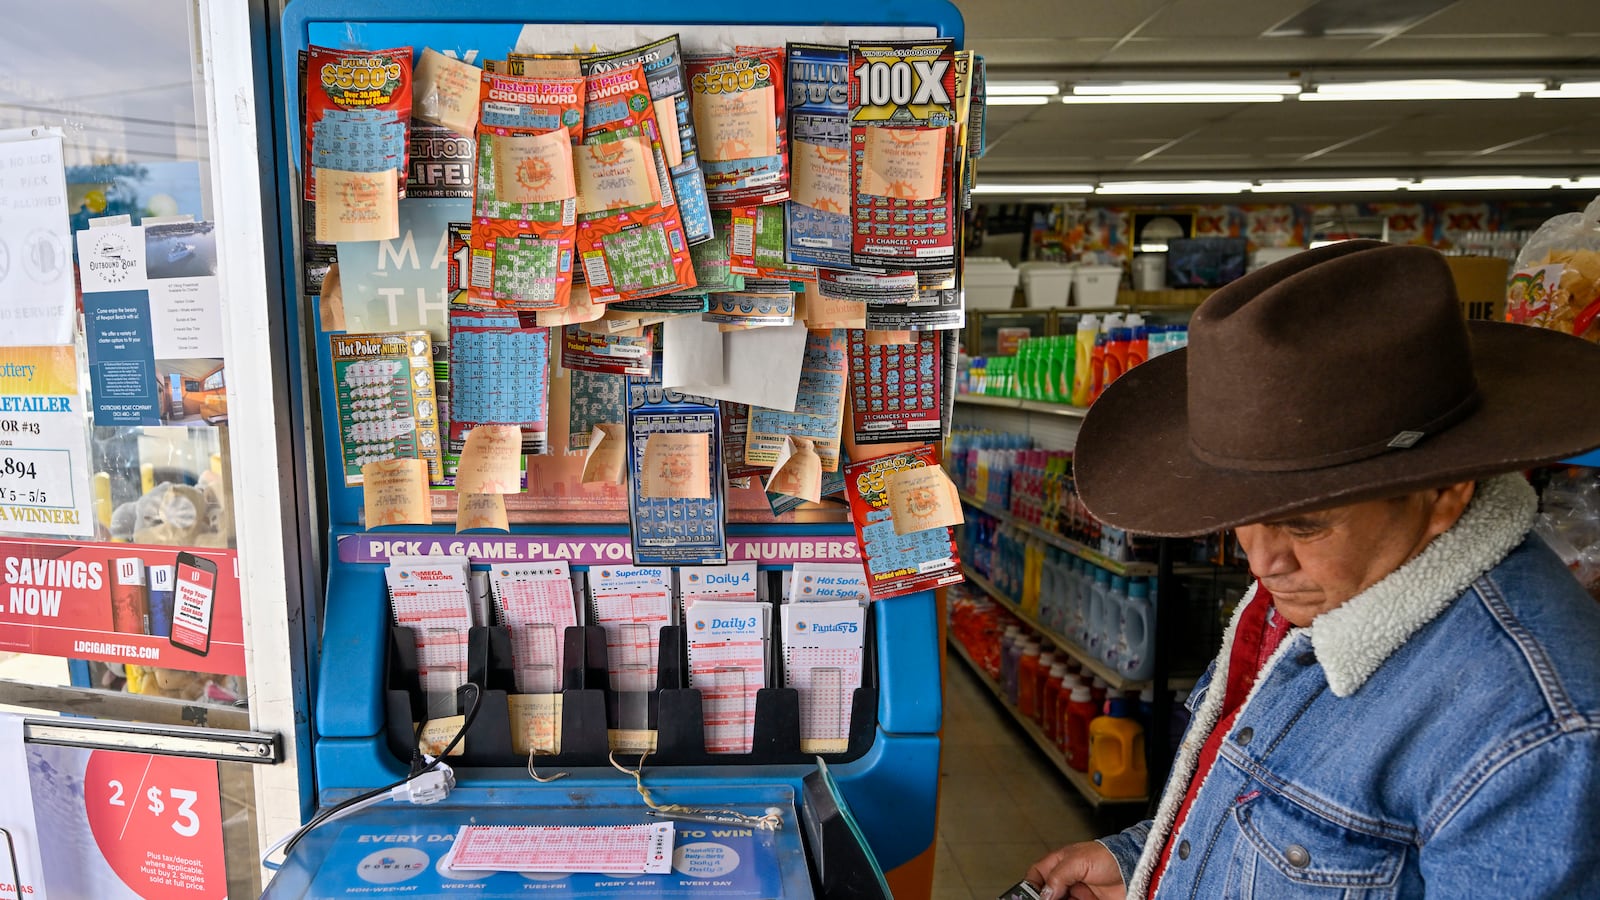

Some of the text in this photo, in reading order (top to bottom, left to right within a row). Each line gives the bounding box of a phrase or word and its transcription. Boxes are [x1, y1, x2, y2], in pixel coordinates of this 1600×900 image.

[342, 58, 382, 68] FULL OF
[710, 61, 749, 74] FULL OF
[321, 63, 400, 90] $500'S
[601, 73, 632, 88] Prize
[854, 60, 951, 107] 100X
[494, 80, 574, 94] Instant Prize
[333, 96, 345, 104] Top
[489, 90, 577, 104] CROSSWORD
[409, 138, 472, 159] ET FOR
[338, 340, 408, 356] Hot Poker NIGHTS
[22, 421, 40, 435] #13
[871, 458, 907, 473] FULL OF
[10, 491, 16, 502] 5
[29, 489, 46, 503] 5/5
[9, 507, 79, 524] WINNER!
[370, 541, 860, 559] PICK A GAME. PLAY NUMBERS.
[5, 557, 103, 590] SAVINGS
[616, 569, 662, 578] SuperLotto
[706, 572, 750, 586] Daily 4
[816, 577, 859, 585] Hot Spot
[815, 588, 858, 598] Hot Spot
[9, 588, 62, 617] NOW
[711, 617, 757, 630] Daily 3
[812, 622, 858, 633] Fantasy 5
[74, 640, 159, 659] LDCIGARETTES.COM
[108, 780, 125, 806] 2
[357, 829, 752, 843] EVERY TO WIN
[146, 851, 161, 860] Plus
[145, 860, 166, 868] where
[140, 866, 157, 875] Must
[158, 869, 170, 879] buy
[180, 872, 205, 883] Singles
[149, 875, 164, 884] sold
[173, 879, 185, 887] full
